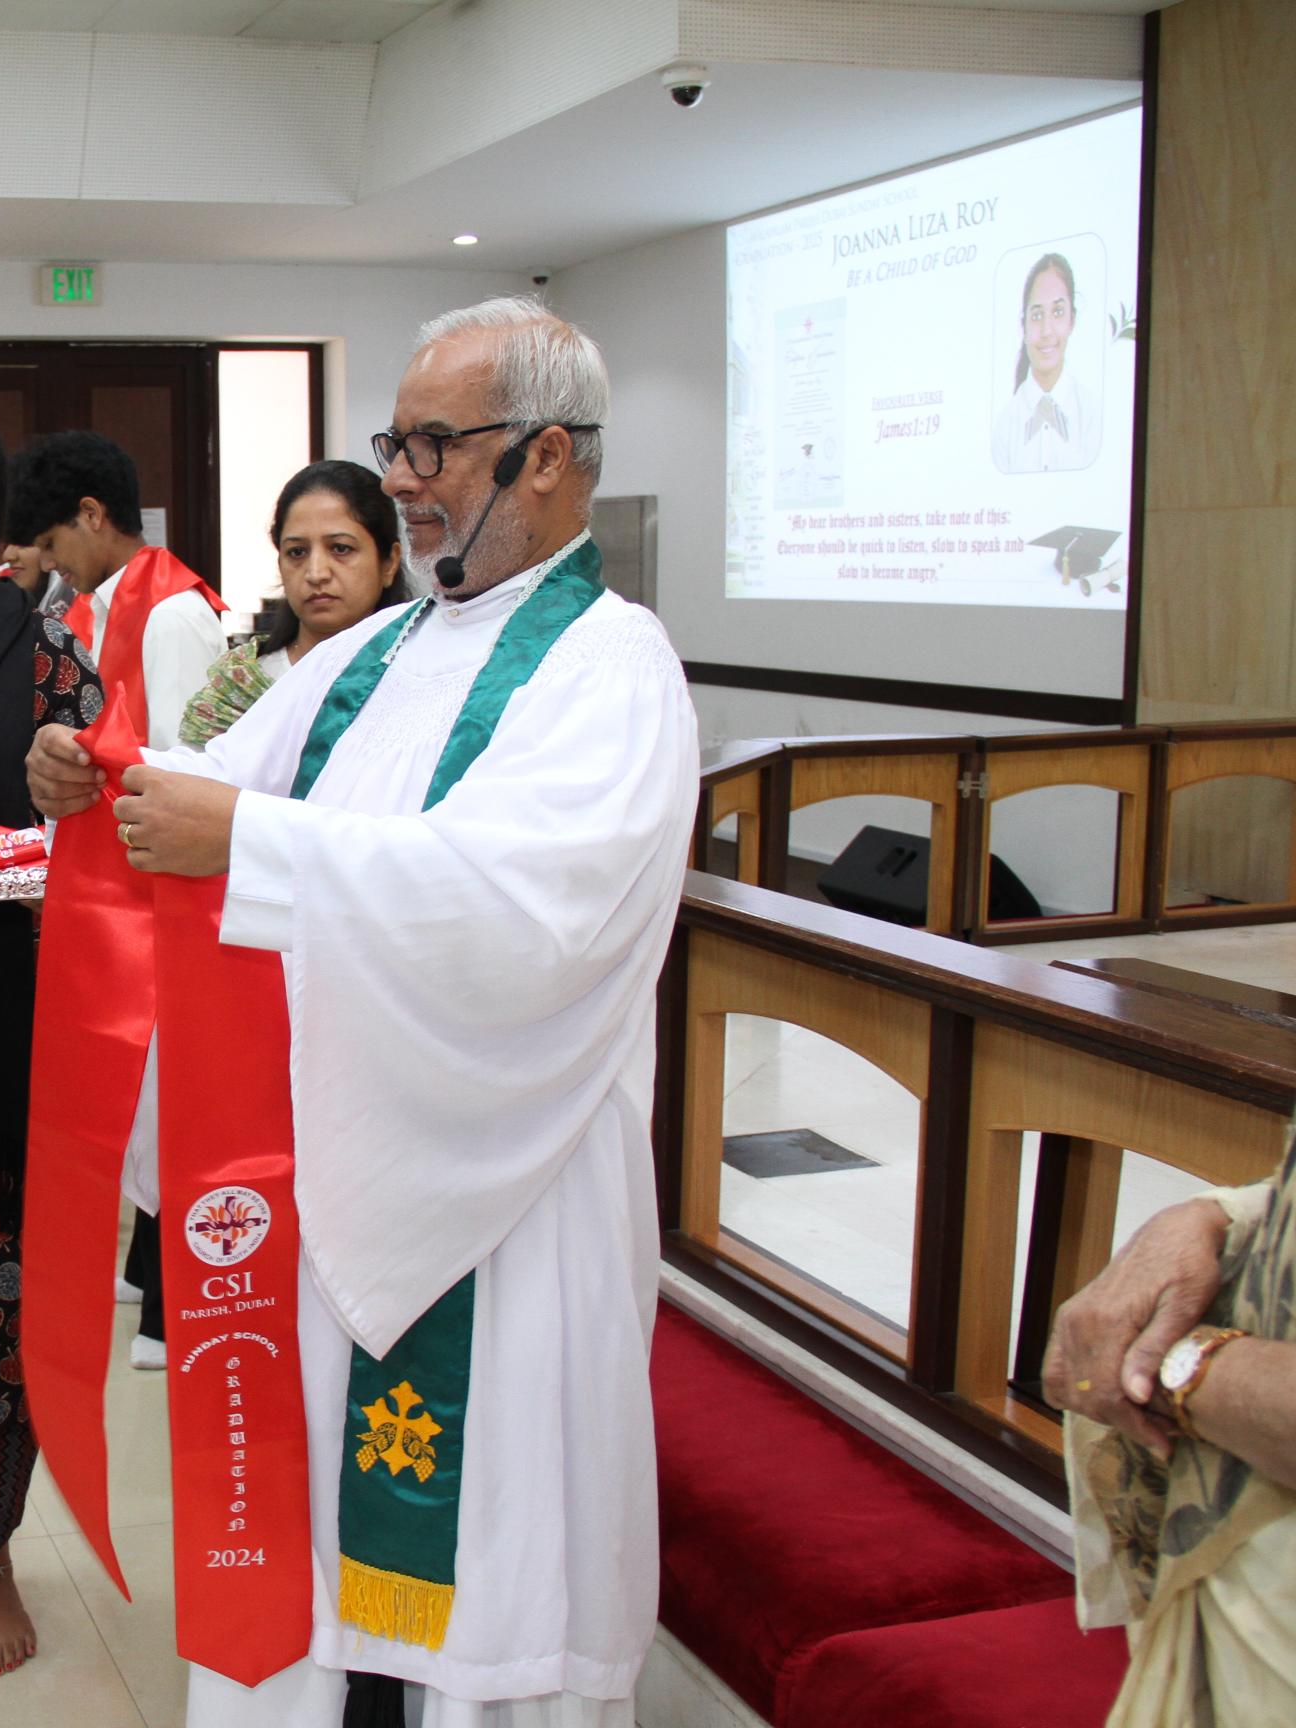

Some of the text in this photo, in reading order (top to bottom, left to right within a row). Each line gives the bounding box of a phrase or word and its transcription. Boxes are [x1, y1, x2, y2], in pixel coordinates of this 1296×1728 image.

[832, 197, 1000, 267] JOANNA LIZA ROY
[846, 244, 978, 288] BE A CHILD OF GOD
[52, 267, 96, 302] EXIT
[808, 514, 827, 529] dear
[829, 512, 865, 530] brothers
[867, 512, 885, 528] and
[926, 509, 946, 526] take
[949, 511, 971, 526] note
[973, 508, 985, 525] of
[817, 538, 846, 556] should
[848, 538, 858, 553] be
[860, 537, 884, 557] quick
[886, 539, 896, 553] to
[931, 537, 955, 553] slow
[958, 538, 968, 553] to
[971, 536, 1001, 556] speak
[1004, 536, 1024, 553] and
[837, 562, 859, 579] slow
[861, 565, 870, 579] to
[872, 562, 905, 580] become
[190, 1204, 202, 1220] THAT
[200, 1271, 254, 1300] CSI
[235, 1297, 277, 1313] DUBAI
[180, 1331, 281, 1373] SUNDAY SCHOOL
[206, 1548, 266, 1568] 2024
